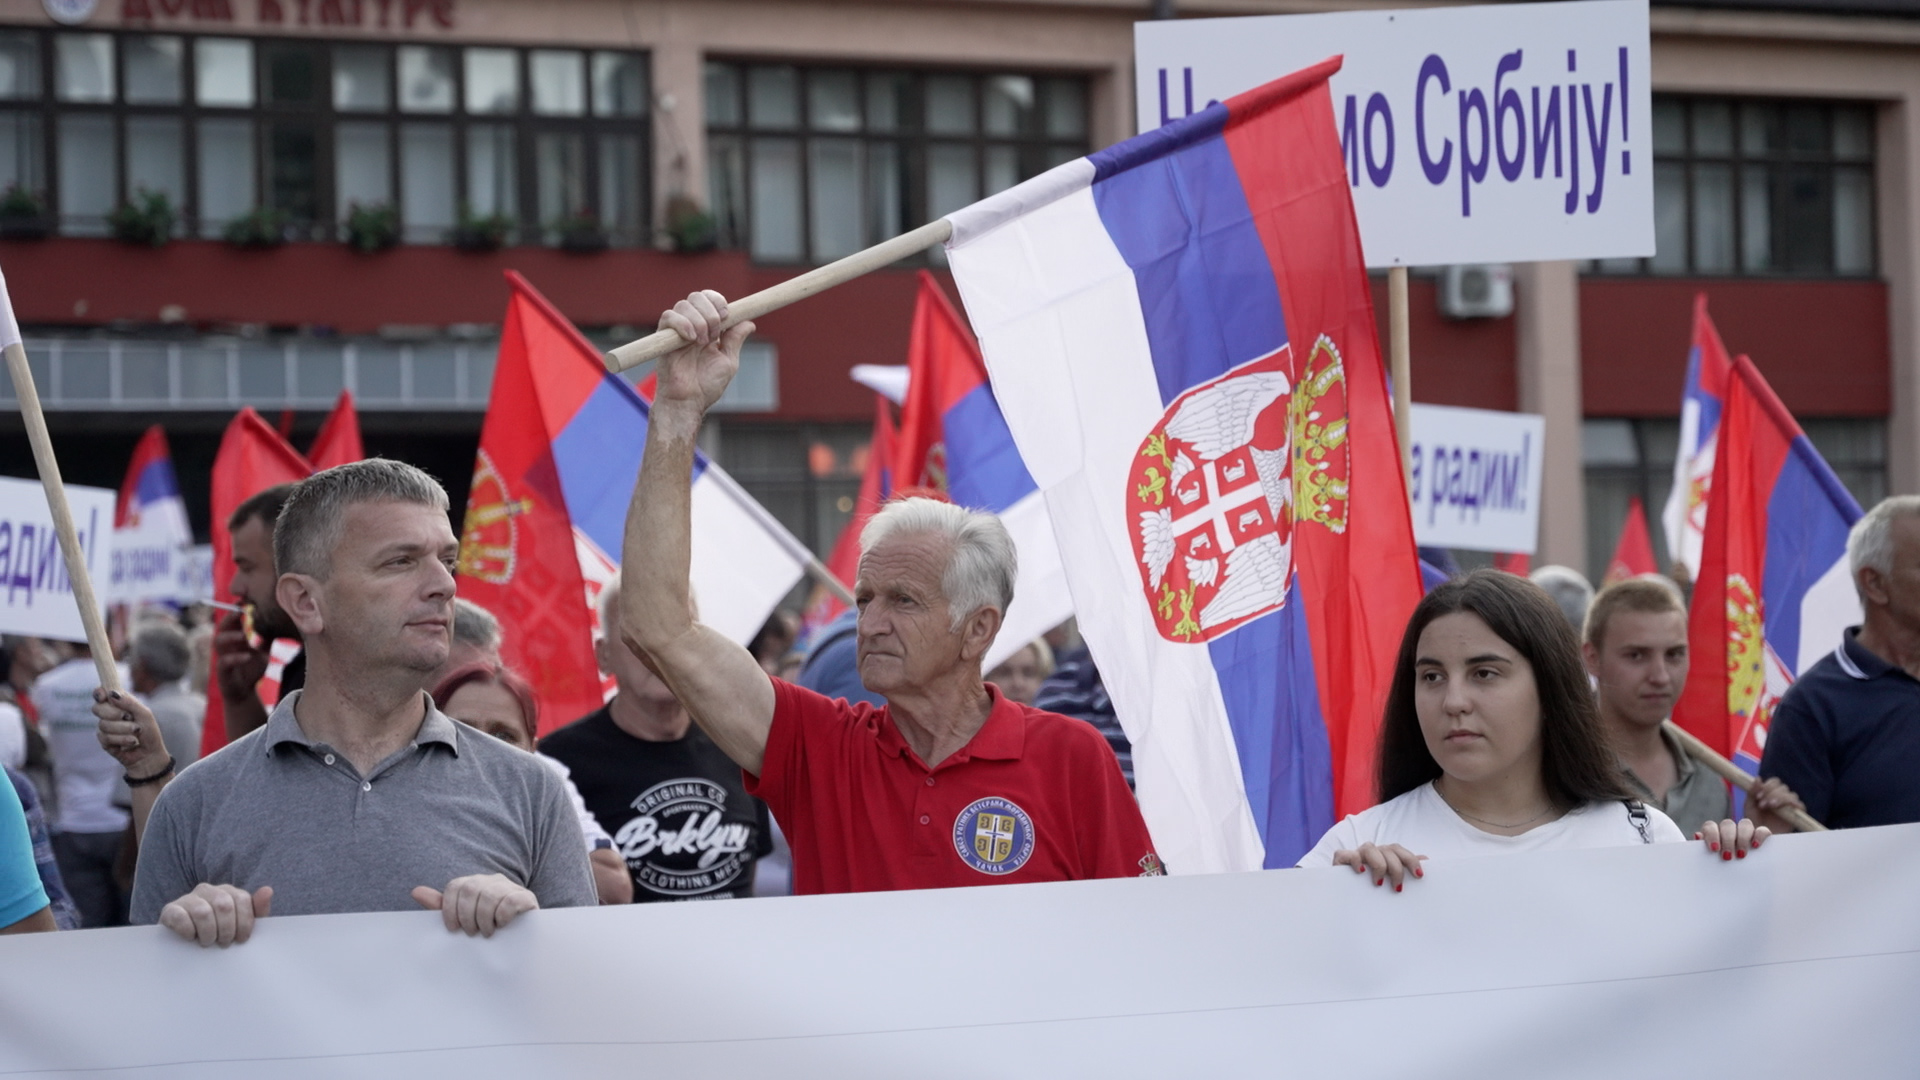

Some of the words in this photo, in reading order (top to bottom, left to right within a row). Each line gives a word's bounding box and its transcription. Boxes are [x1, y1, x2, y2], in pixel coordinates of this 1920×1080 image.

[1415, 46, 1631, 217] Србију!
[636, 783, 705, 814] ORIGINAL
[707, 786, 726, 804] CO
[614, 809, 750, 869] Brklyn
[640, 866, 712, 889] CLOTHING
[975, 860, 1004, 872] ЧАЧАК
